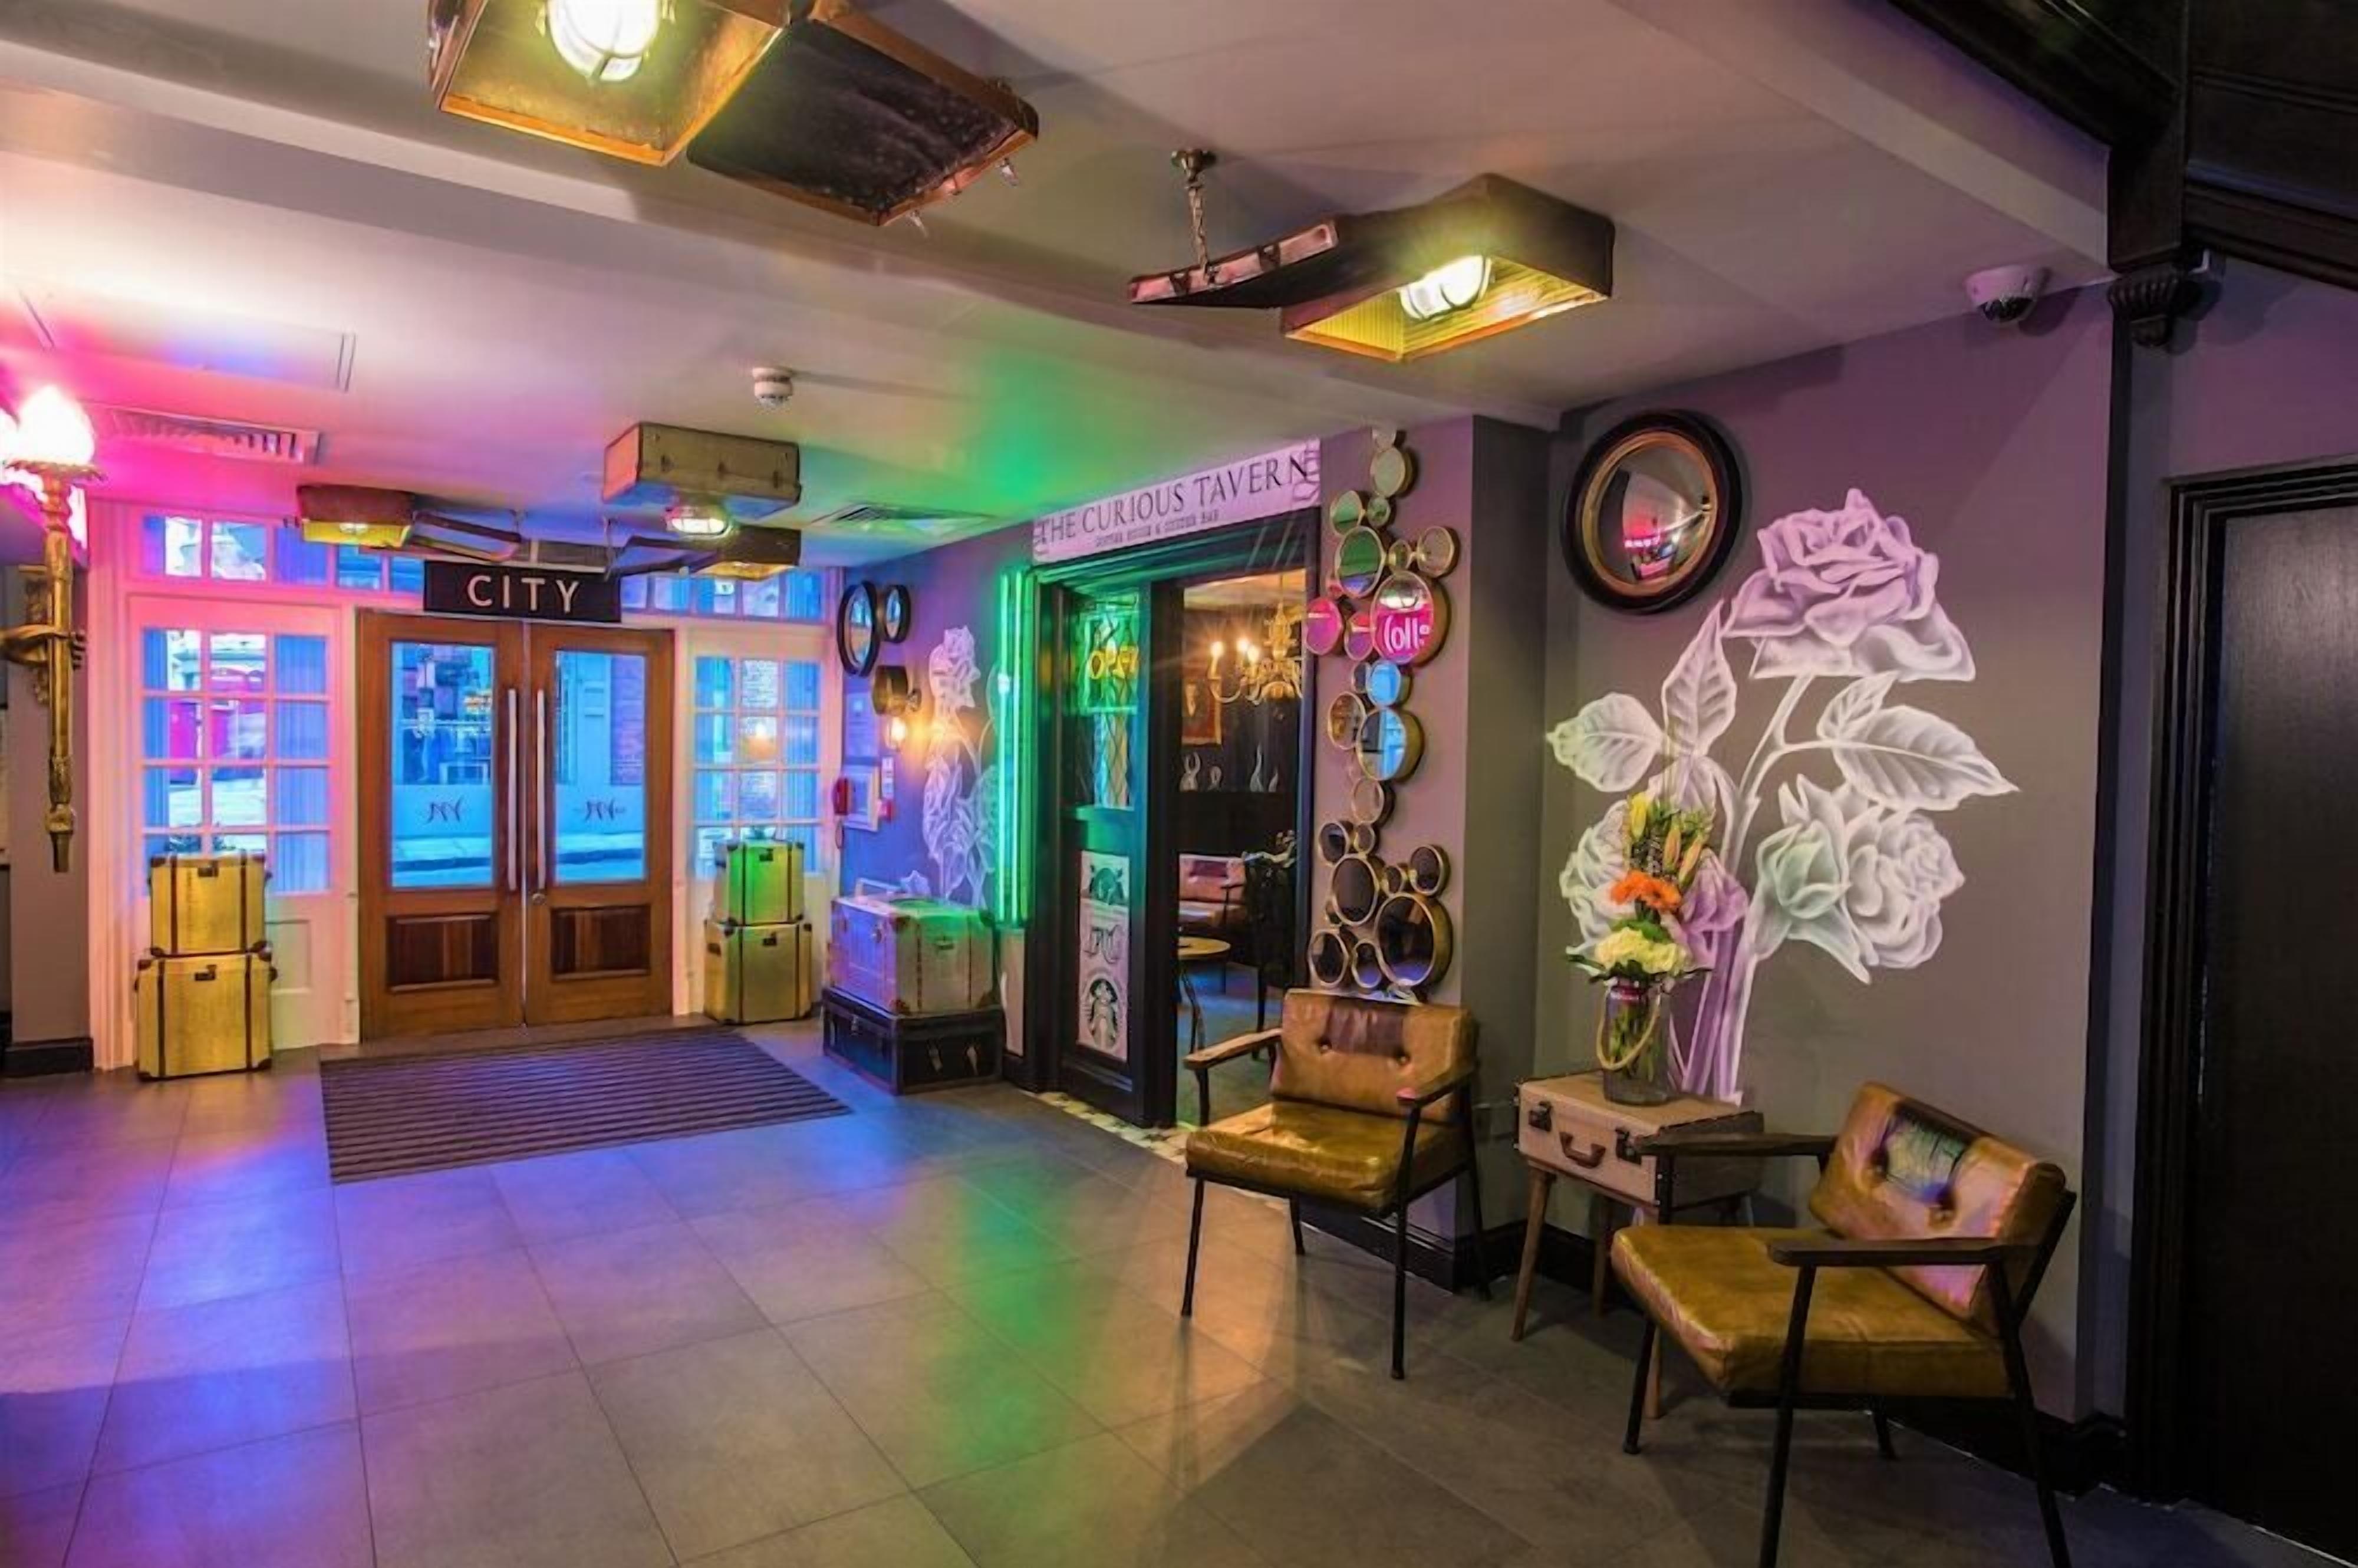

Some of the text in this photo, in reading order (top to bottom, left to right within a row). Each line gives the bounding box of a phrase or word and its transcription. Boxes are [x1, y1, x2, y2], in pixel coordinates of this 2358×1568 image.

[1039, 513, 1076, 543] THE
[1082, 483, 1184, 533] CURIOUS
[1194, 454, 1308, 508] TAVERN
[467, 575, 579, 614] CITY
